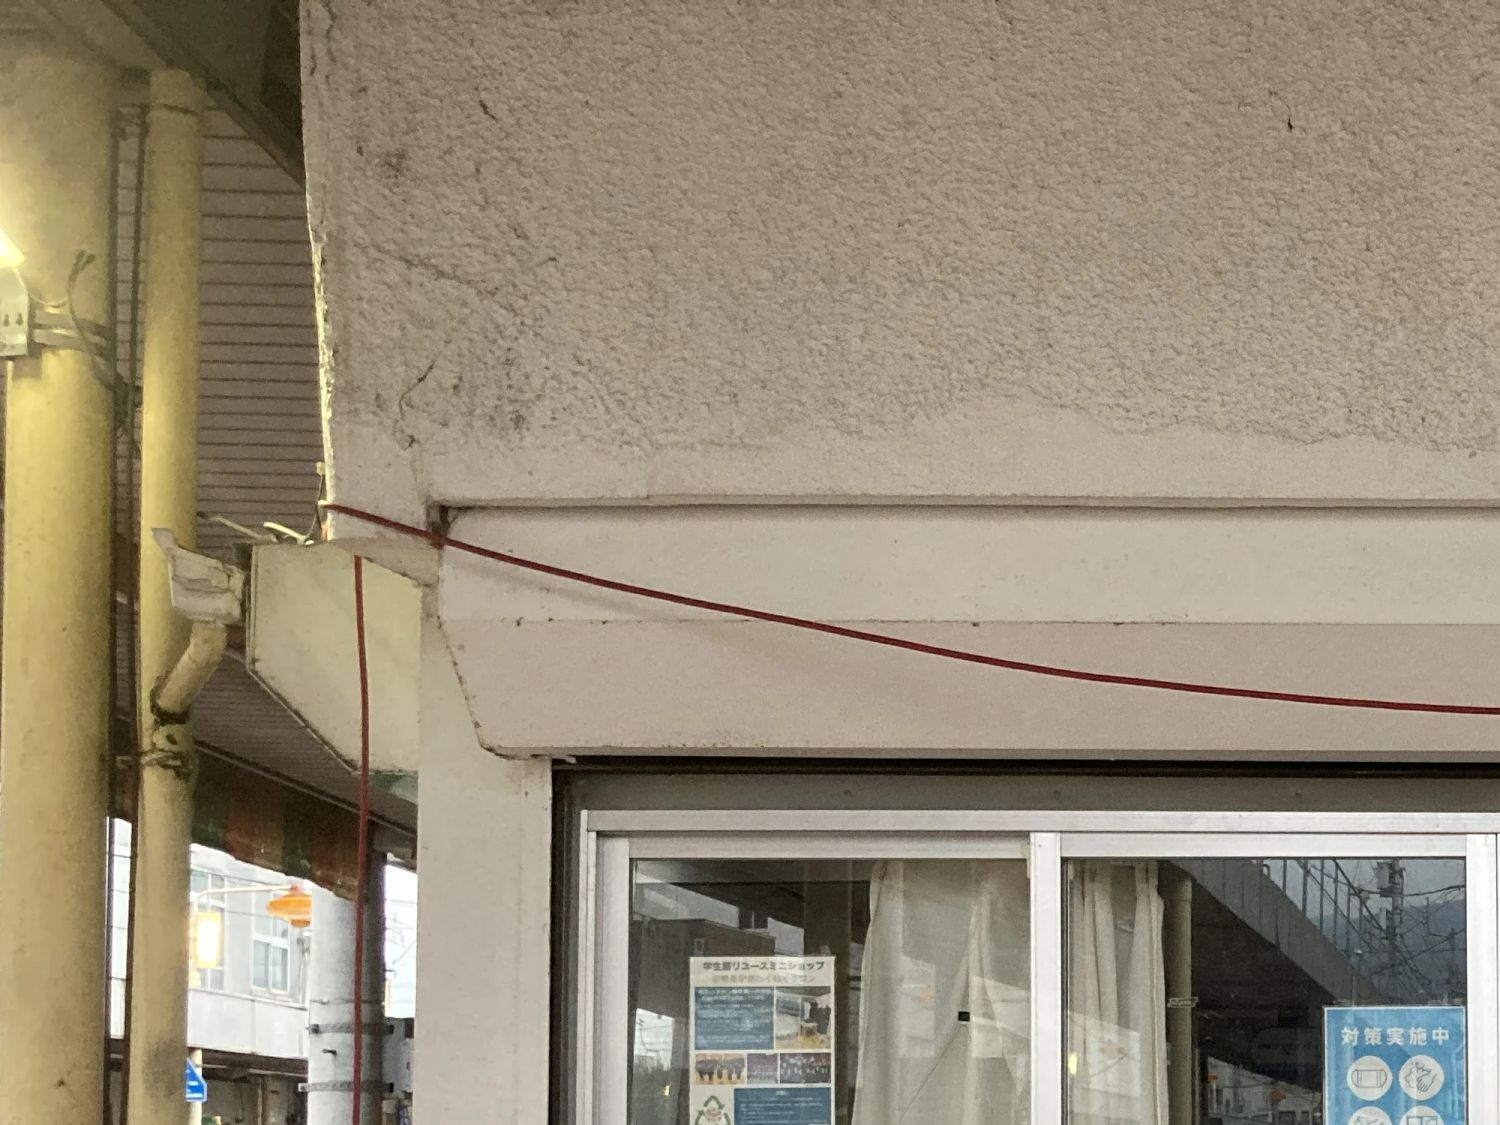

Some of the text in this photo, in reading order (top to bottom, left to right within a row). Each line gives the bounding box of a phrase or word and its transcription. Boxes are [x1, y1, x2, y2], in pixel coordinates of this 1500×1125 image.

[1341, 1027, 1450, 1046] 対策実施中
